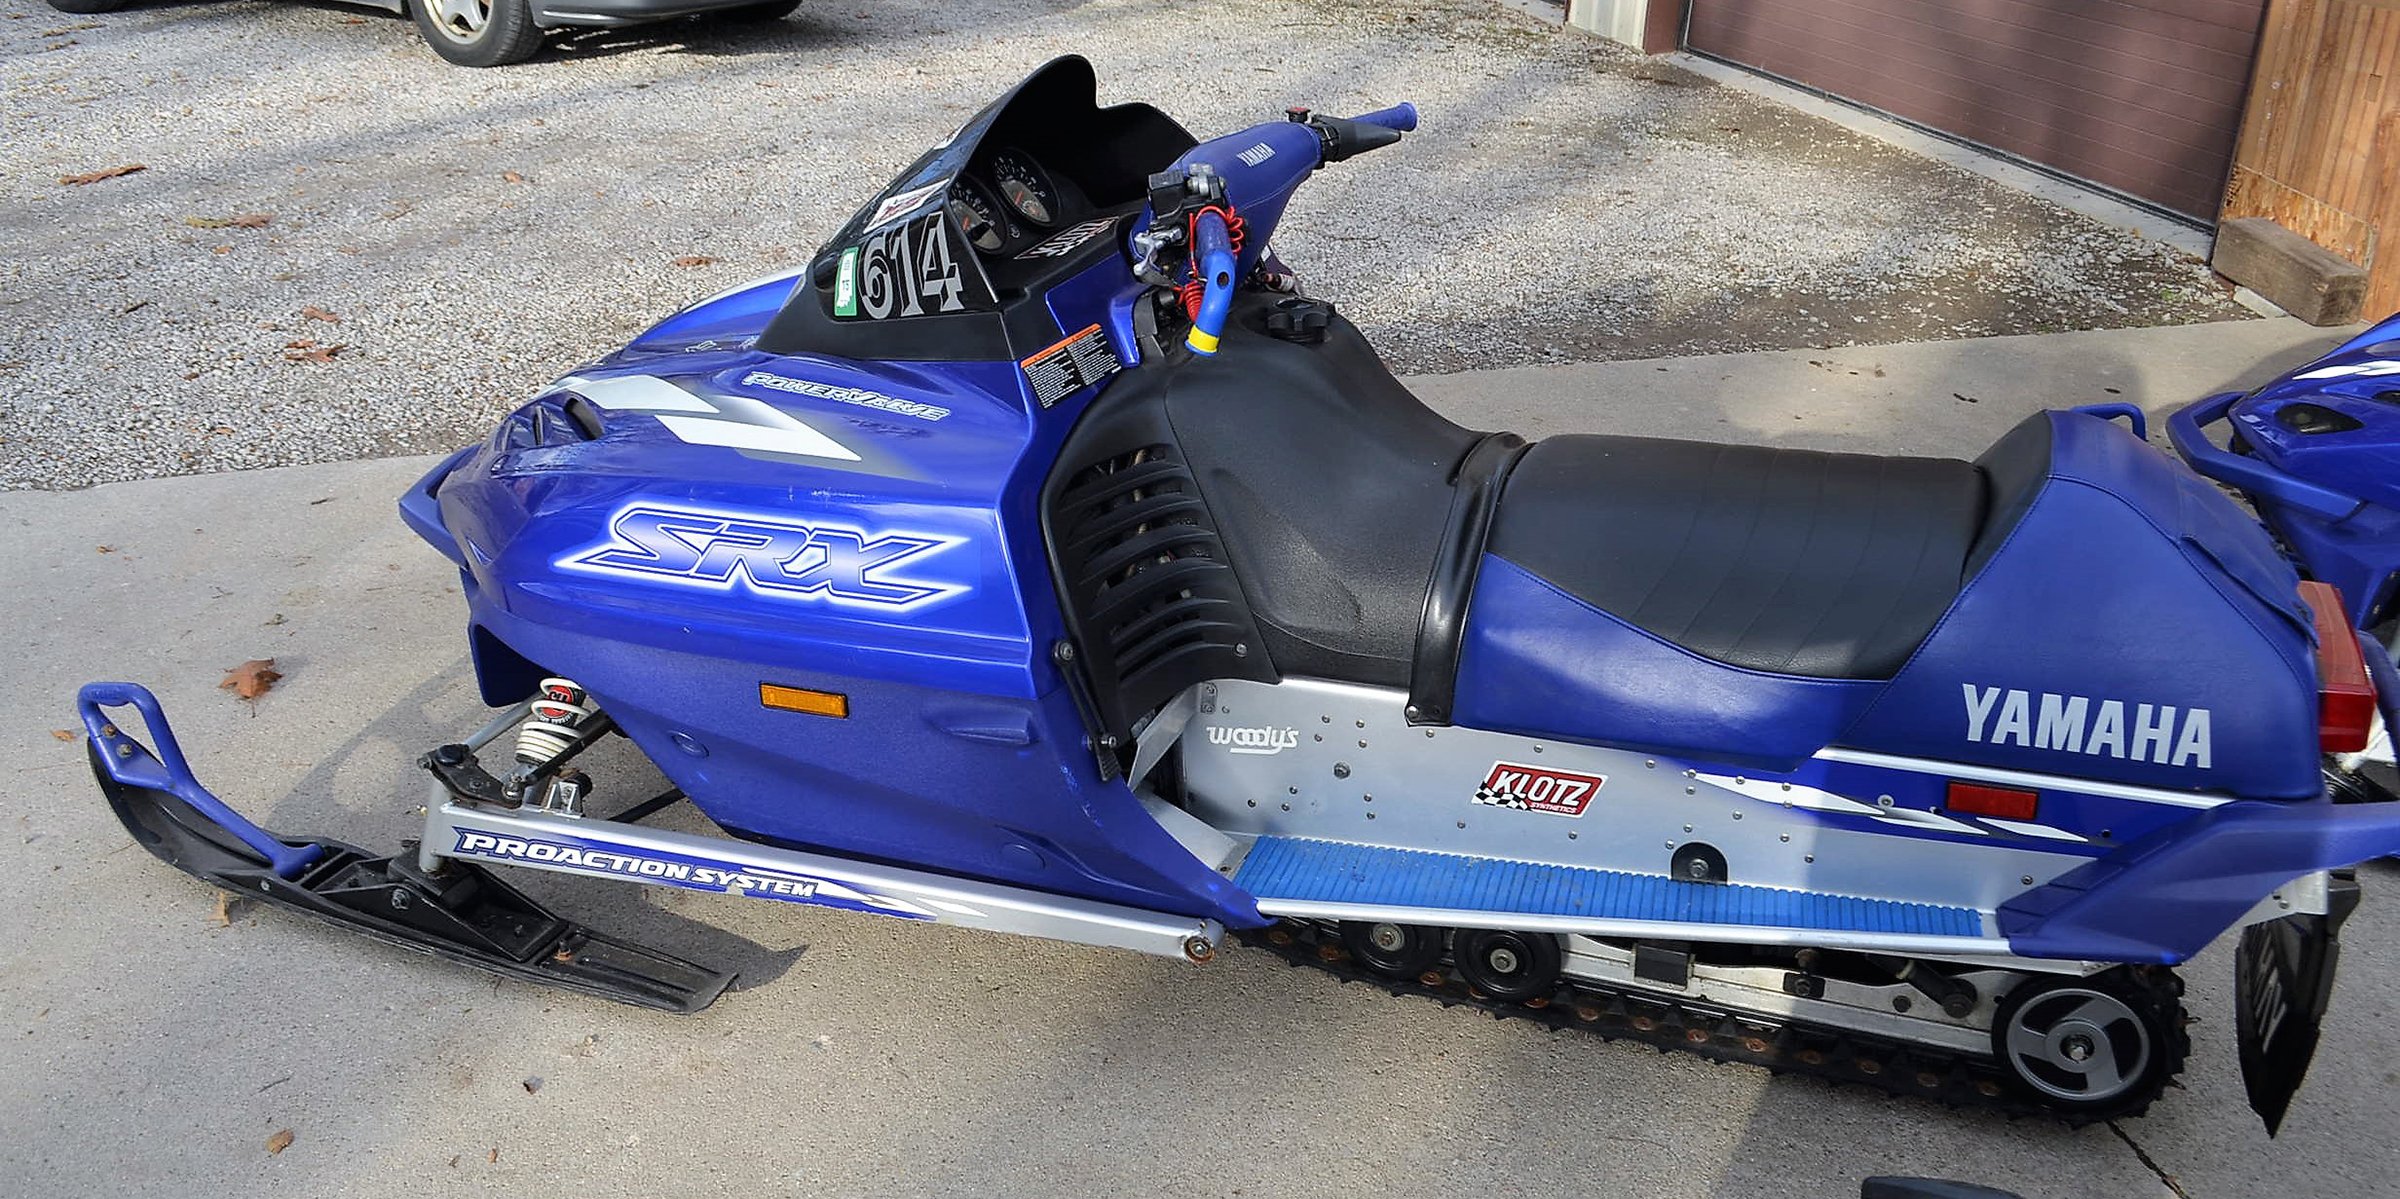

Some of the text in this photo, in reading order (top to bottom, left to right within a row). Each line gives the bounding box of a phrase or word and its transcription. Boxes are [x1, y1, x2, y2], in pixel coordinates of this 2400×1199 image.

[857, 211, 965, 320] 614
[574, 508, 947, 605] SRX
[1206, 725, 1299, 755] woody's
[1962, 683, 2212, 769] YAMAHA
[1492, 770, 1592, 807] KLOTZ
[1529, 801, 1578, 814] SYNTHETICS
[461, 832, 817, 898] PROACTION SYSTEM
